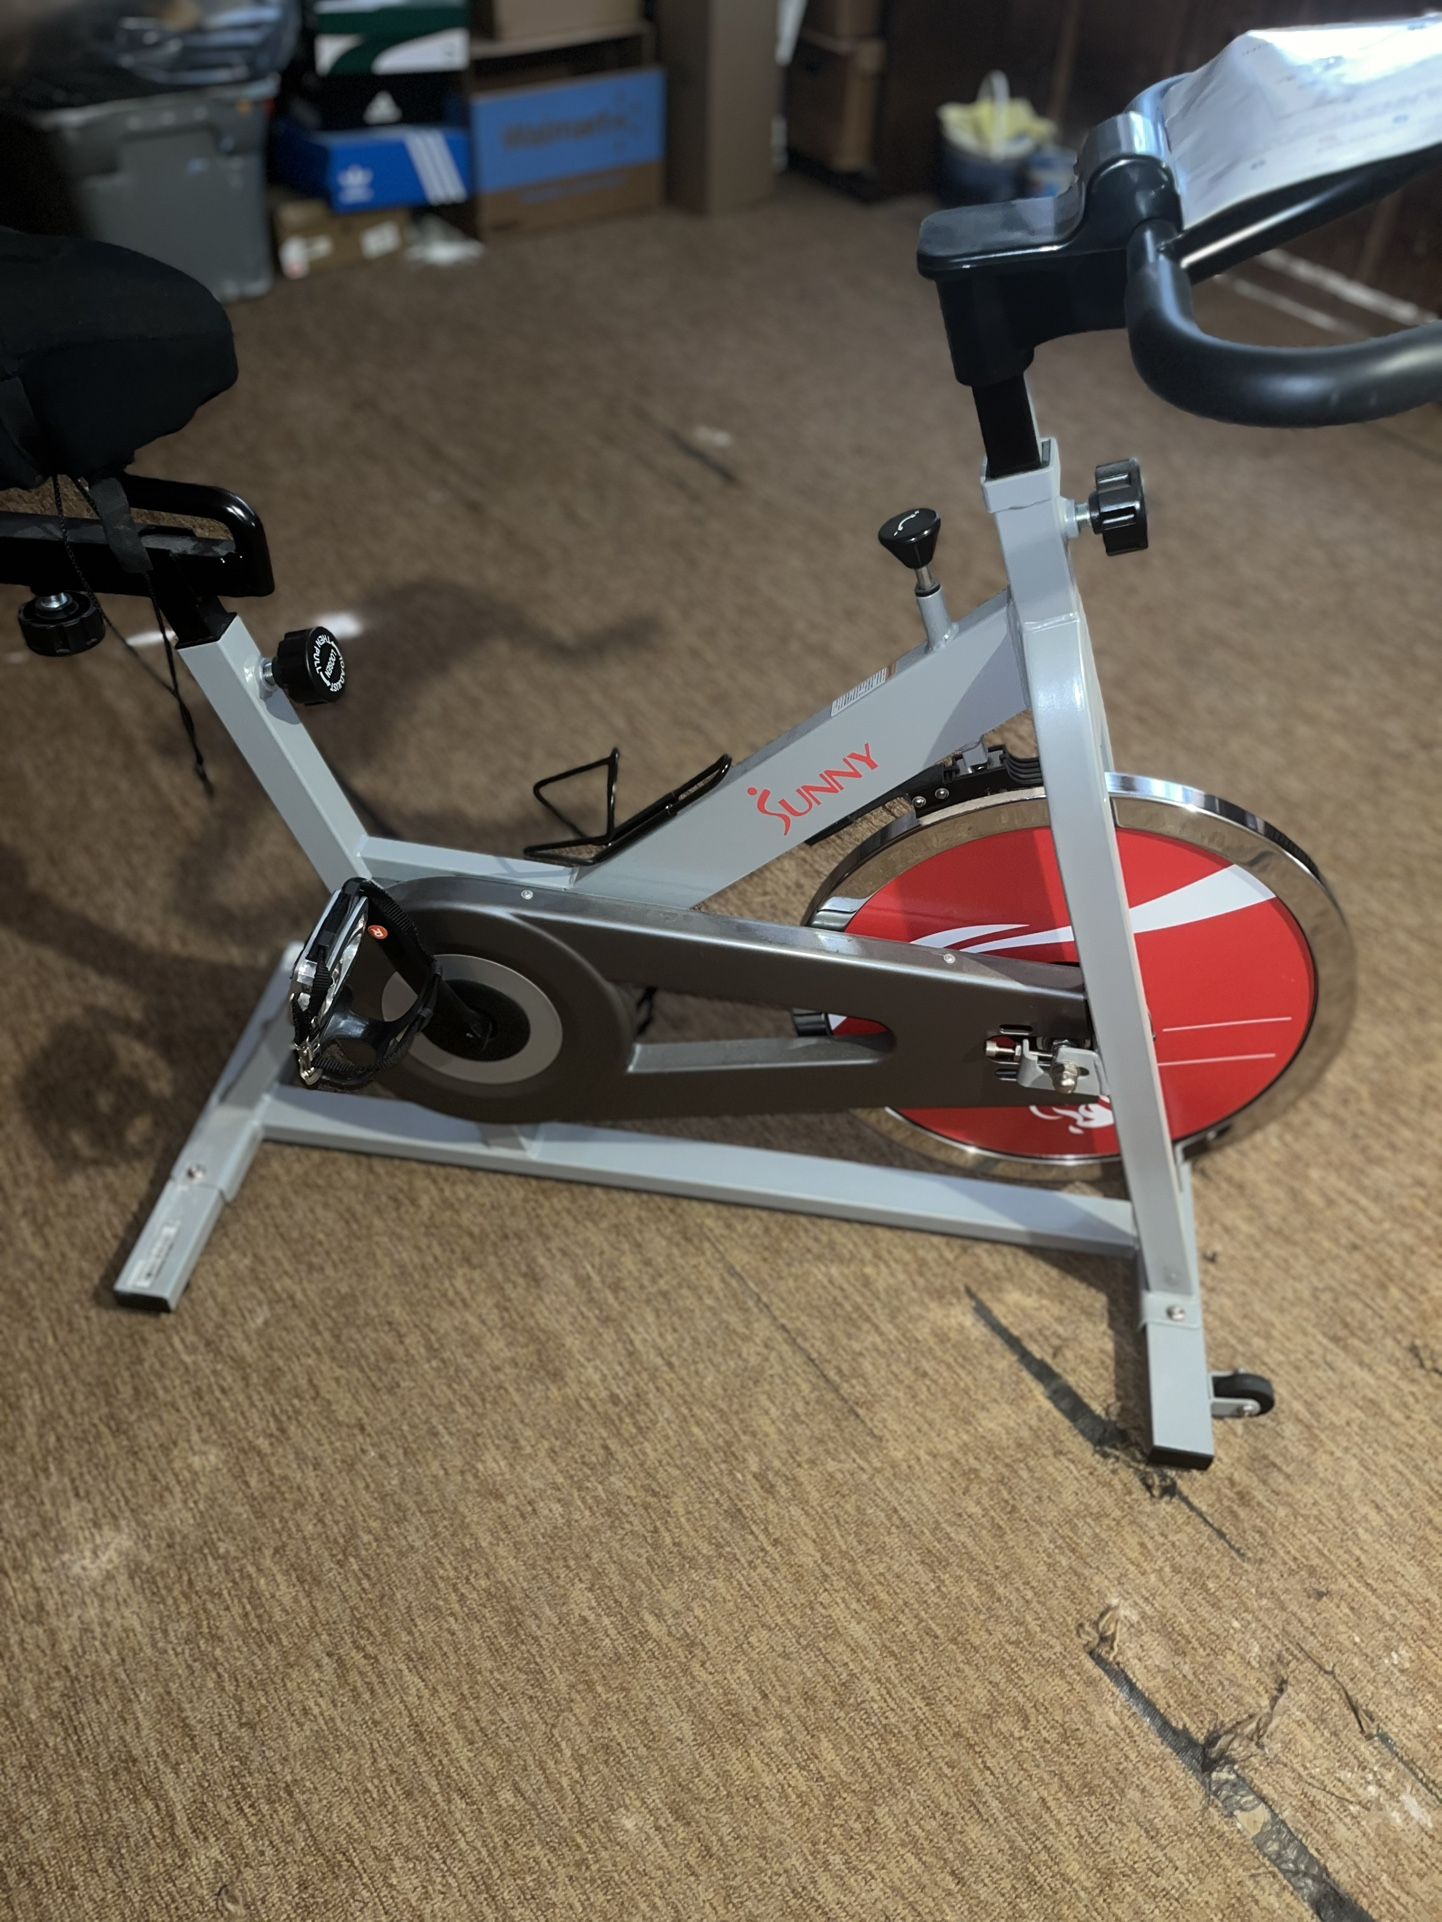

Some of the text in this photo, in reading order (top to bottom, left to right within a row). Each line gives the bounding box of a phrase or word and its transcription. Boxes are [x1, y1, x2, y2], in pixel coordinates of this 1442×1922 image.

[313, 646, 322, 673] PULL
[325, 649, 337, 678] LOOSEN
[748, 743, 878, 836] SUNNY
